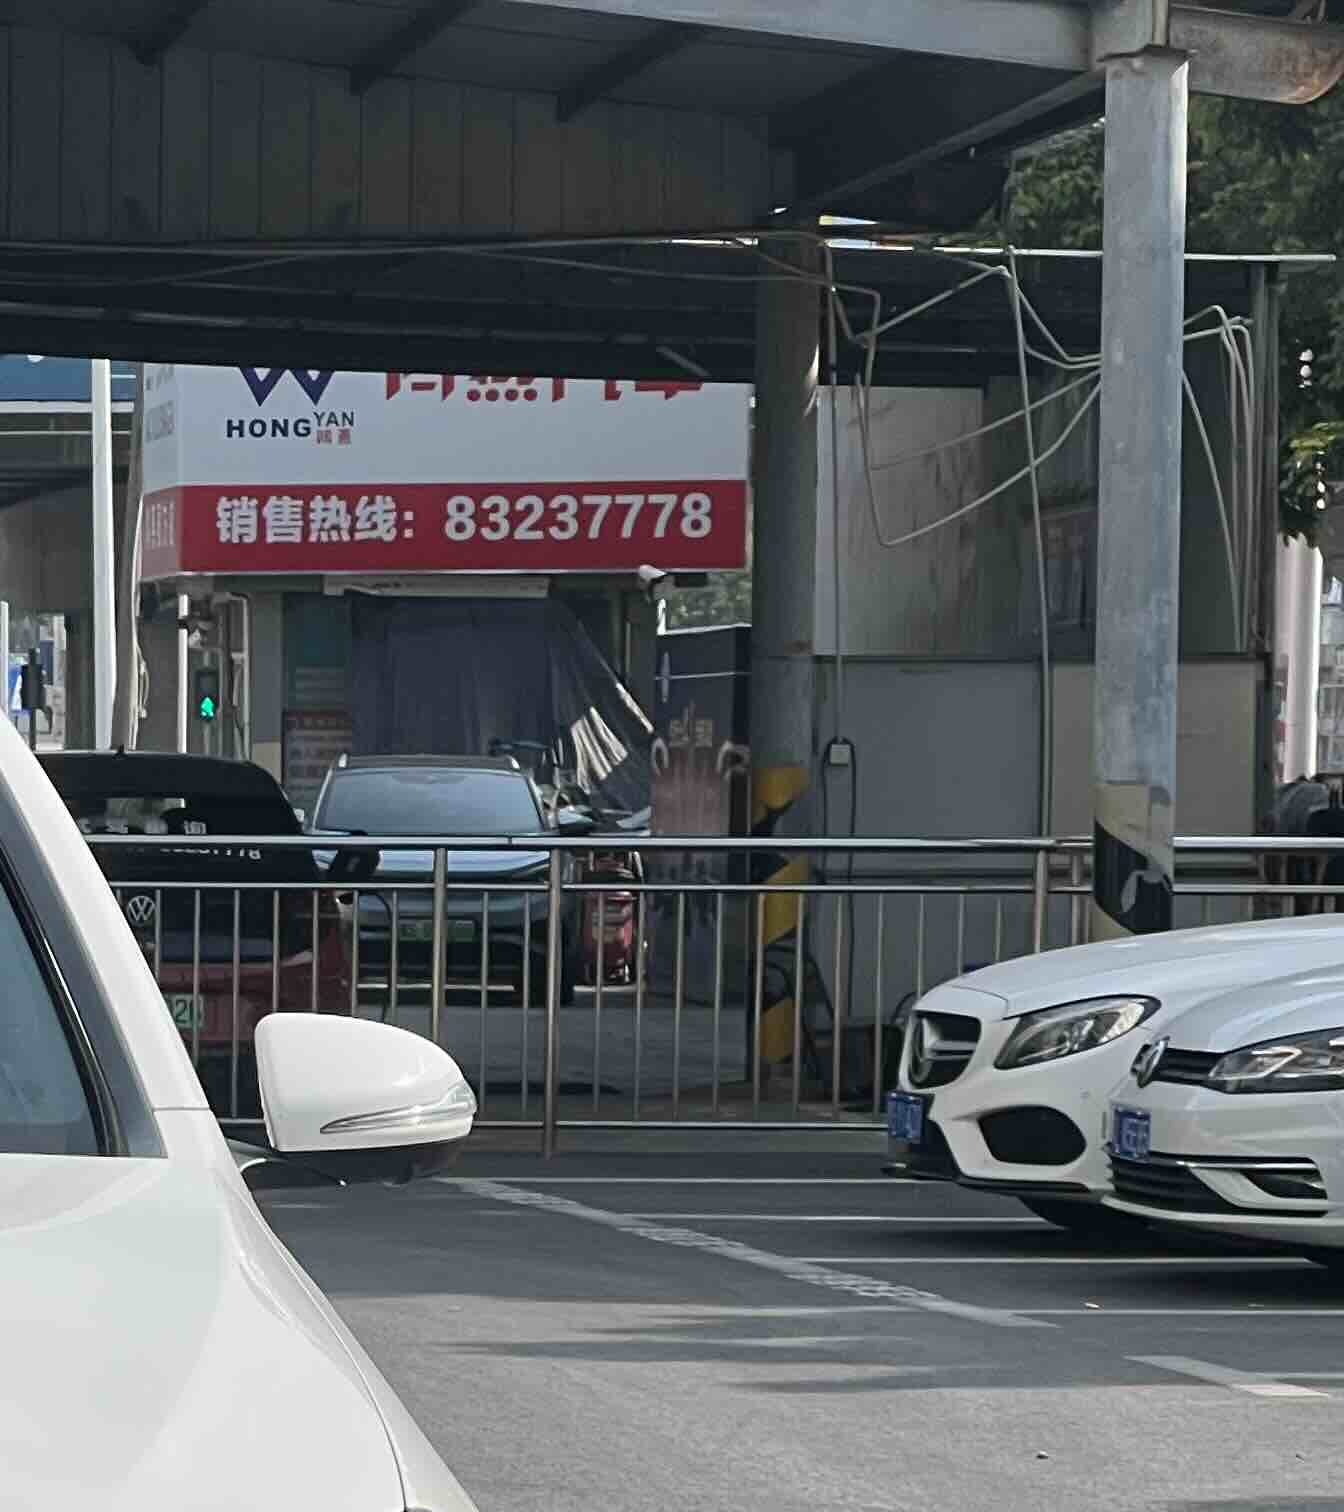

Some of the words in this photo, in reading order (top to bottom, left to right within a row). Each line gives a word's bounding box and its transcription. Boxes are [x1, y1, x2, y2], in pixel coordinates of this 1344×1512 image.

[226, 418, 311, 438] HONG
[313, 411, 355, 427] YAN
[216, 495, 414, 544] 销售热线：
[444, 493, 712, 542] 83237778
